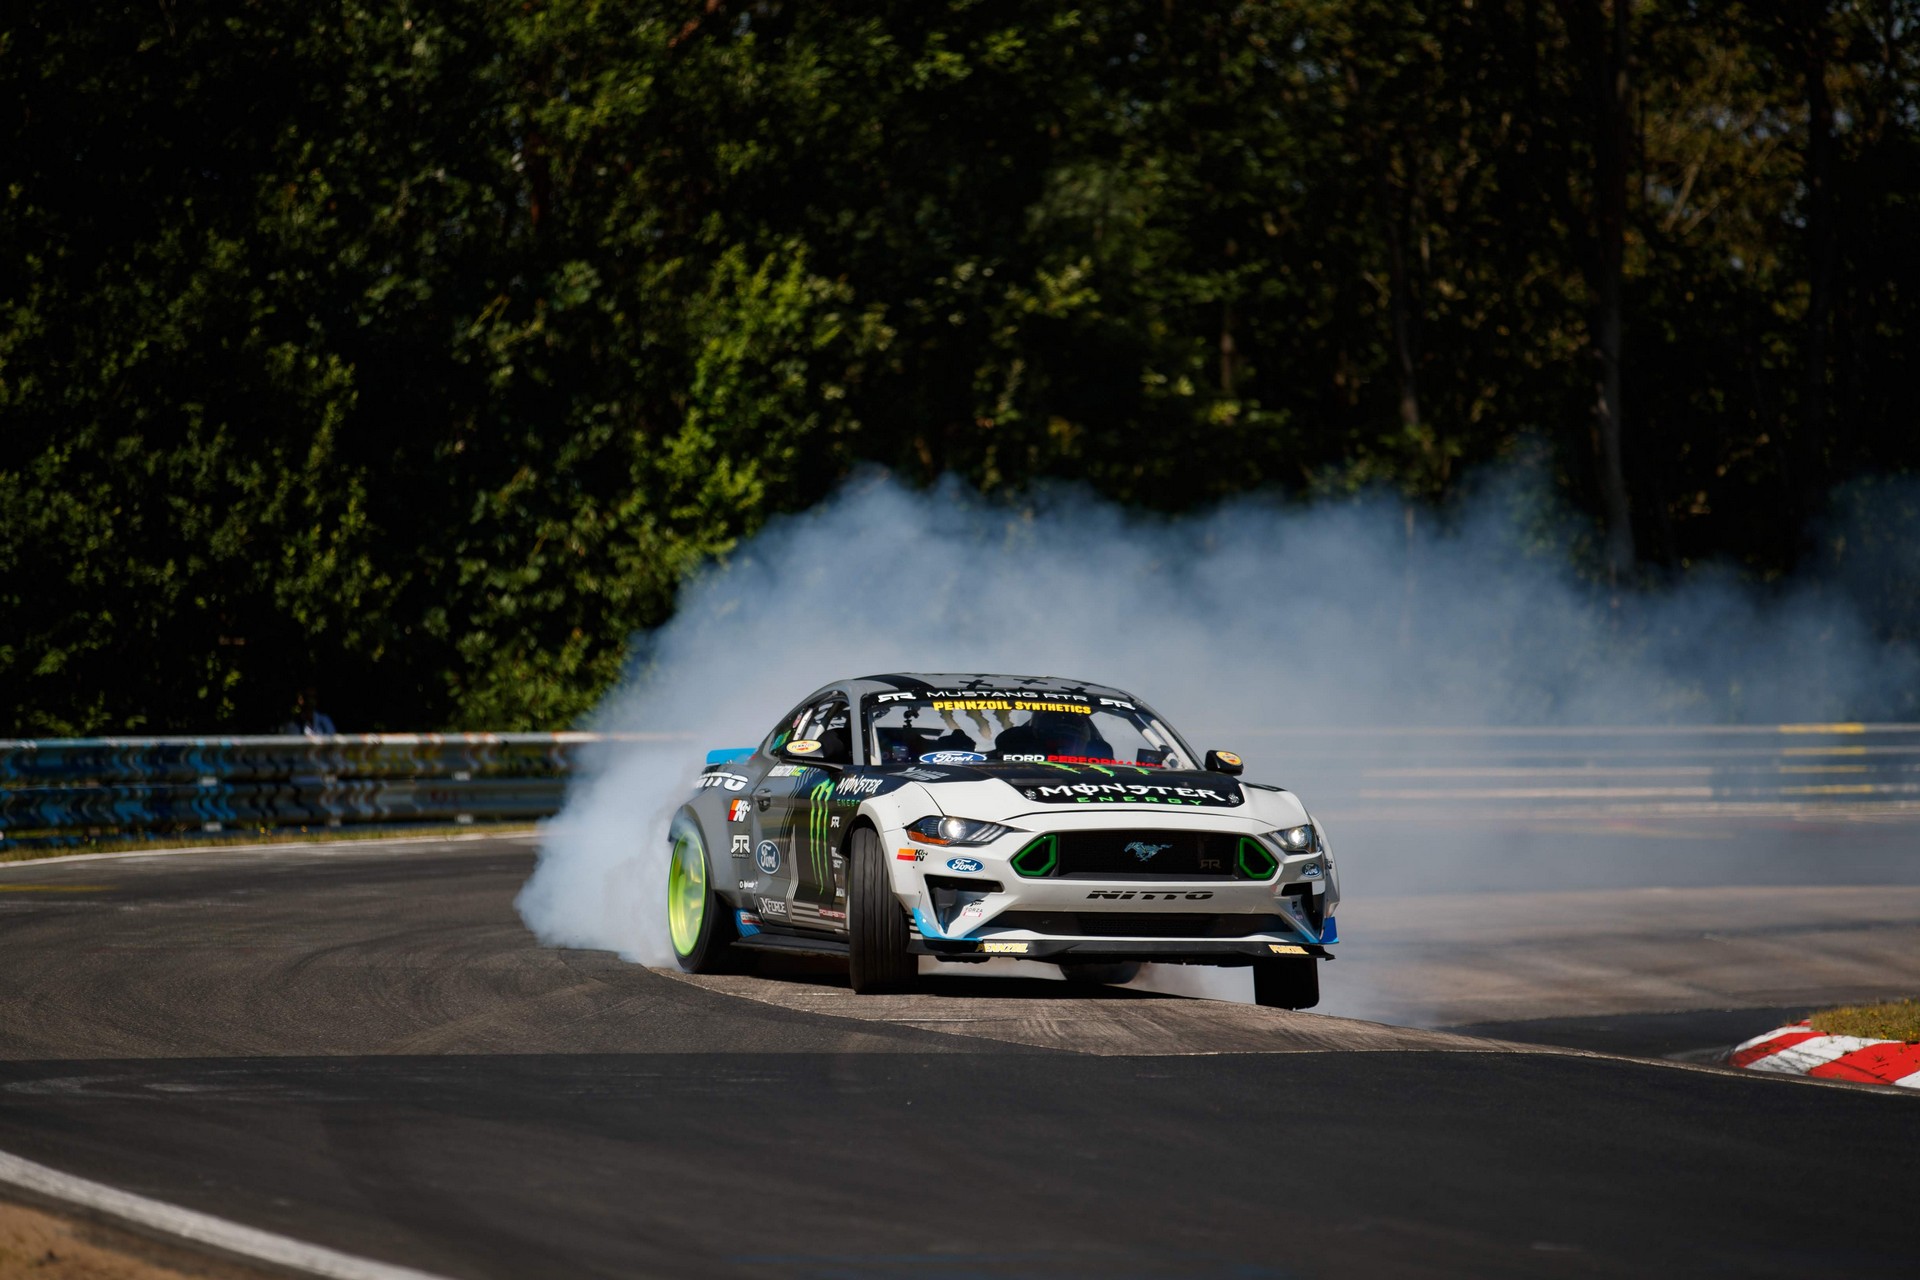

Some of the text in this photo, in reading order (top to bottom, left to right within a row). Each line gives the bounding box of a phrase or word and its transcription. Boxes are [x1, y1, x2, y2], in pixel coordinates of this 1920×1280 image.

[1043, 693, 1088, 701] RTR
[932, 700, 1091, 714] PENNZOIL SYNTHETICS
[932, 752, 974, 763] Ford
[1003, 754, 1045, 762] FORD
[836, 775, 883, 796] MONSTER
[1037, 782, 1226, 802] MONSTER
[1076, 796, 1202, 806] ENERGY
[951, 858, 977, 871] Ford
[1086, 890, 1214, 900] NITTO
